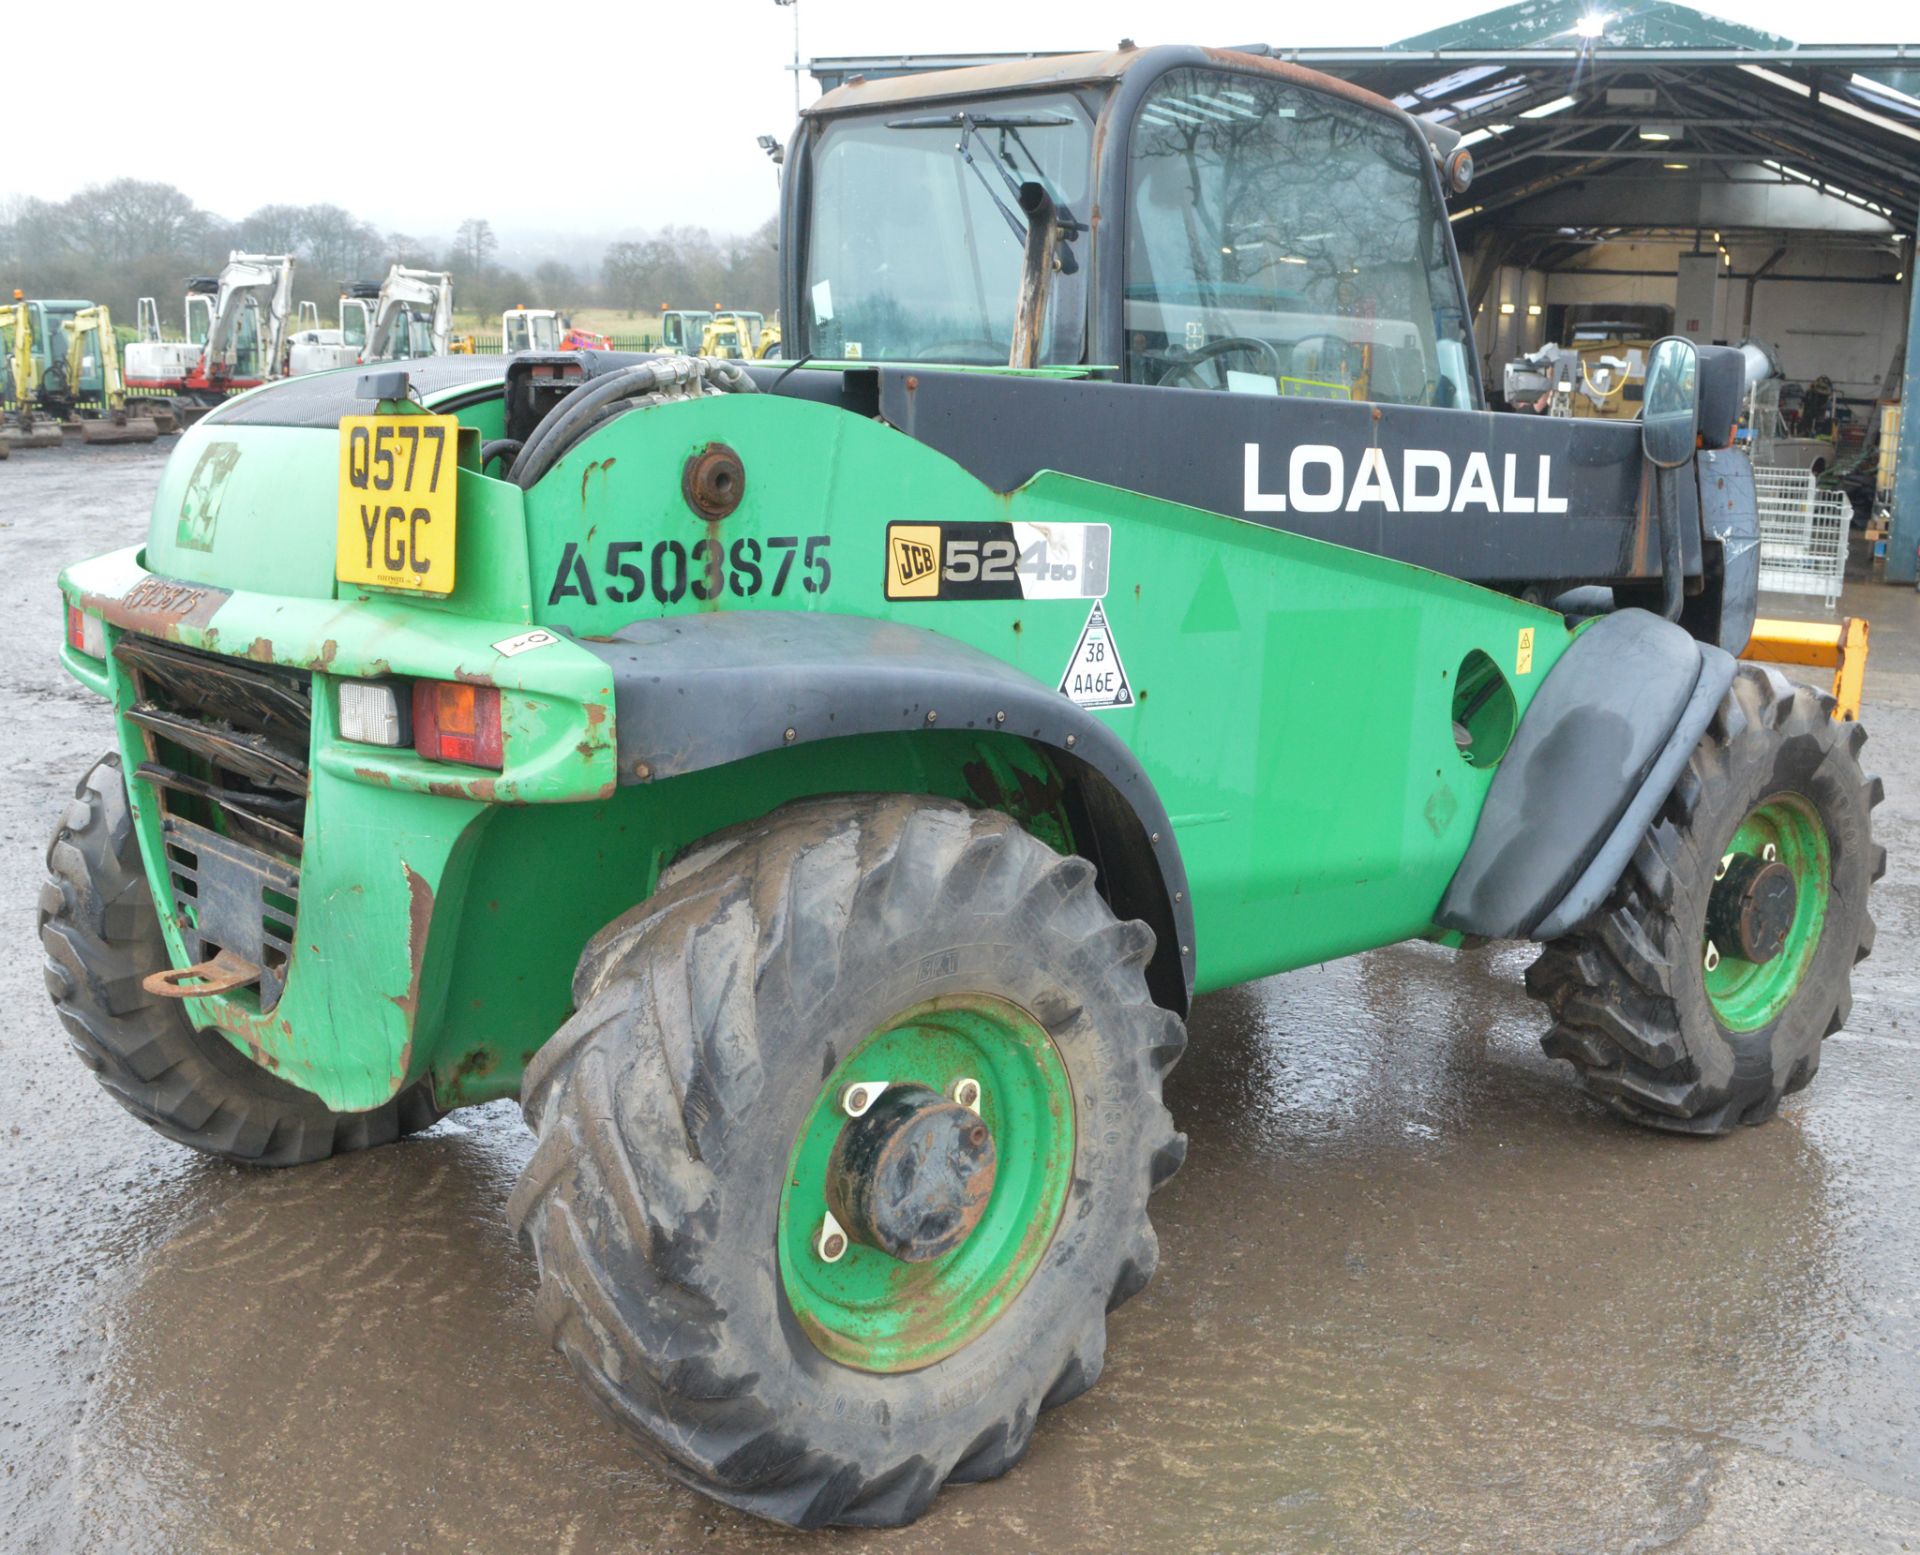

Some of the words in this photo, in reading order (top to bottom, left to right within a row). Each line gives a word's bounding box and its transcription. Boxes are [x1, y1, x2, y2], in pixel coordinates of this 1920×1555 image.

[348, 426, 446, 493] Q577
[1244, 442, 1569, 514] LOADALL
[359, 504, 432, 574] YGC
[900, 543, 934, 580] JCB
[1085, 642, 1104, 662] 38
[1073, 672, 1114, 694] AA6E
